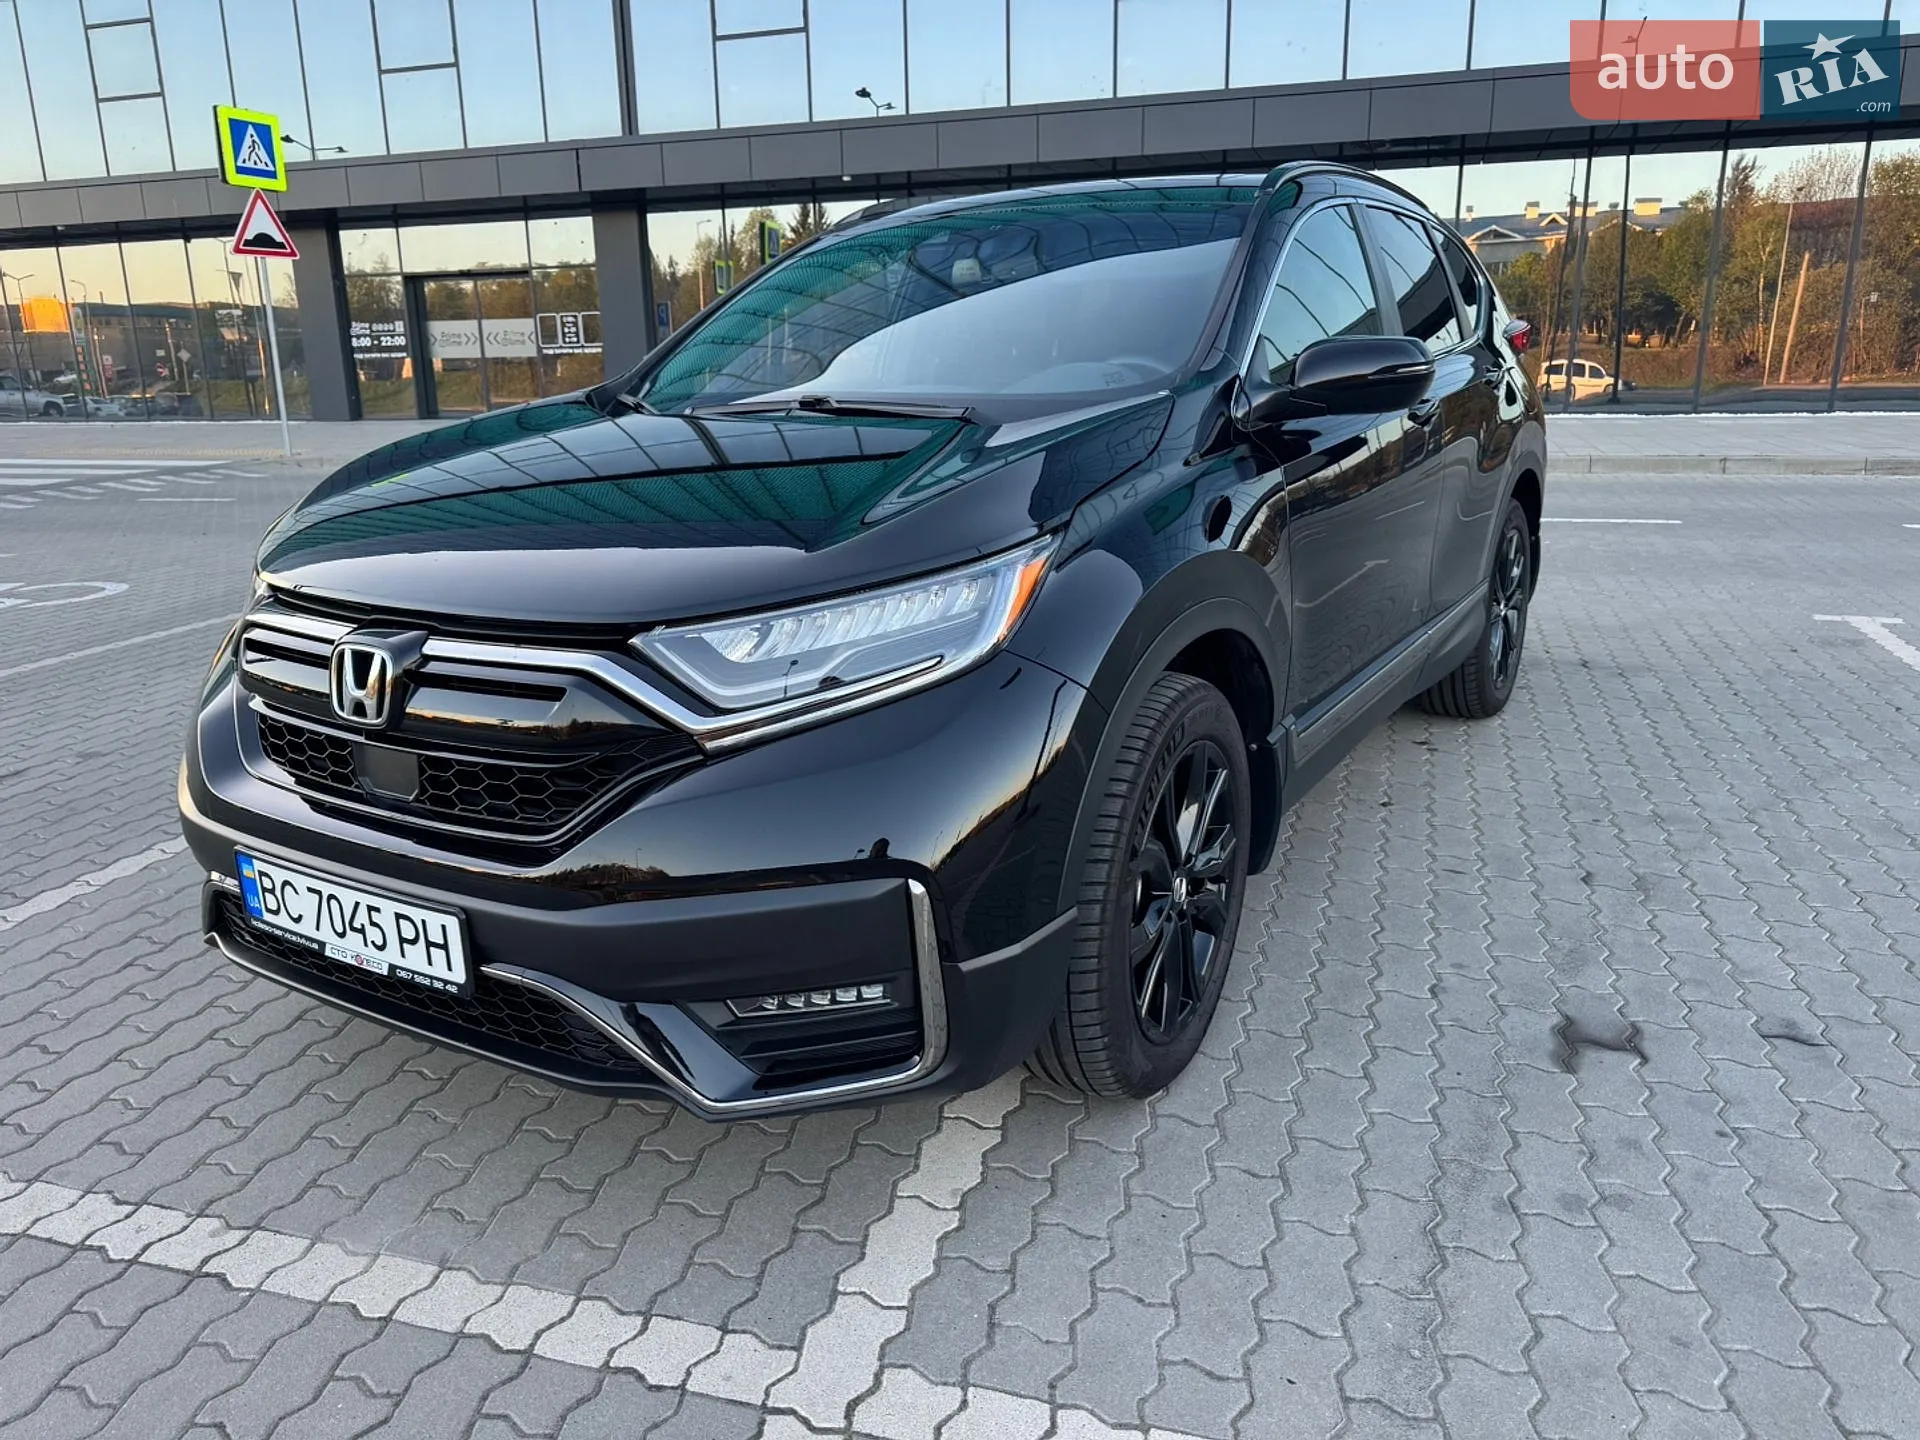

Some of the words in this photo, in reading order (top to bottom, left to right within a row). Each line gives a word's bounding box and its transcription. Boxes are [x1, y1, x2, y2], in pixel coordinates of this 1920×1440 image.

[351, 336, 371, 347] 8:00
[380, 335, 406, 347] 22:00
[248, 895, 261, 909] UA
[258, 870, 303, 924] BC
[306, 886, 388, 952] 7045
[394, 911, 453, 972] PH
